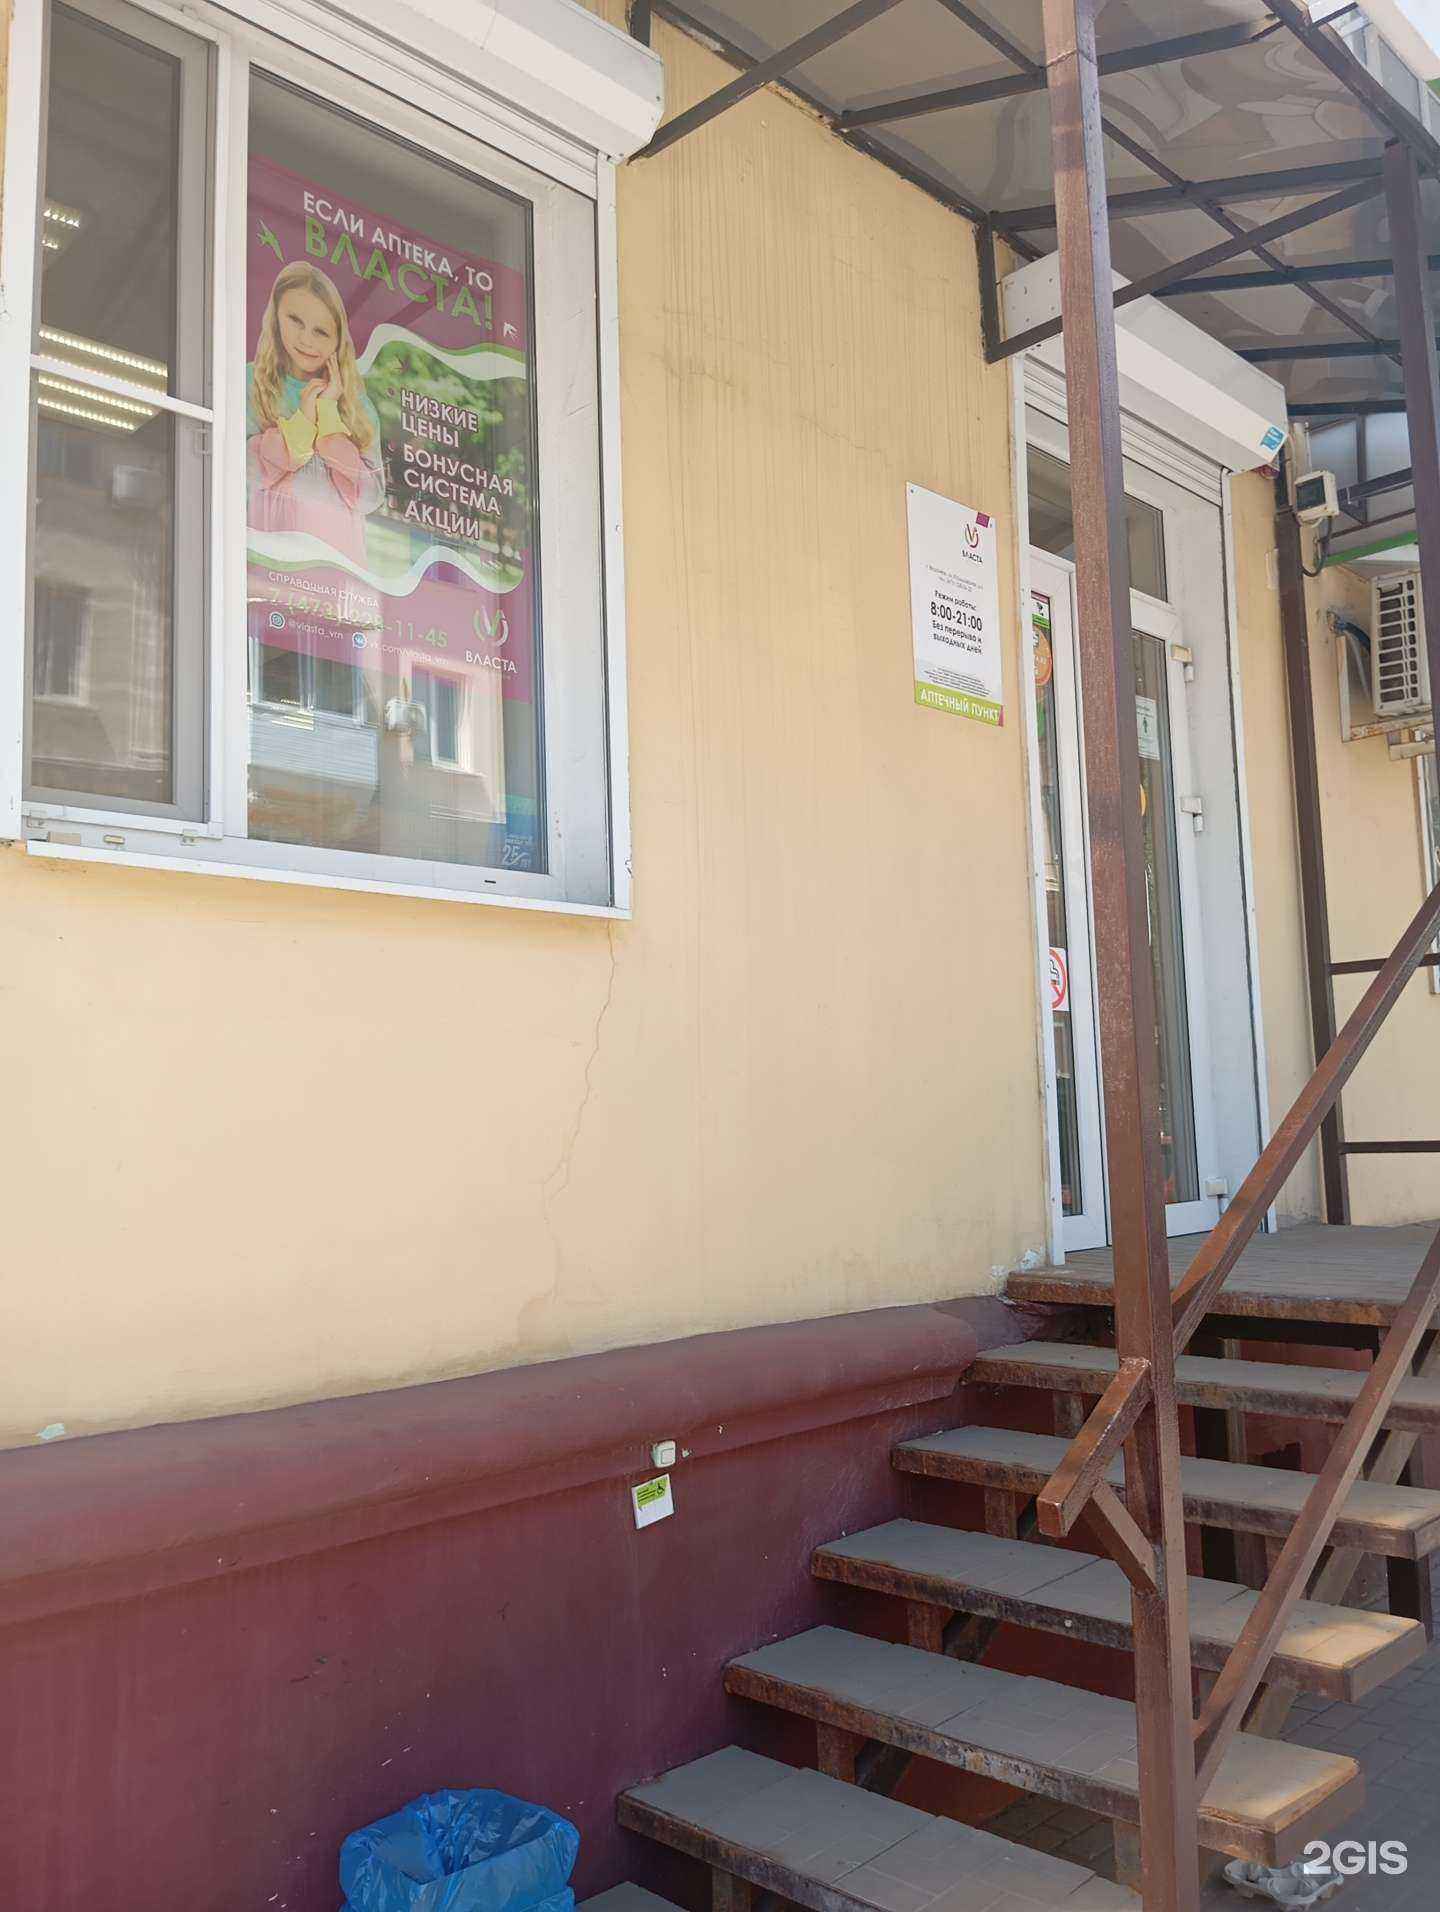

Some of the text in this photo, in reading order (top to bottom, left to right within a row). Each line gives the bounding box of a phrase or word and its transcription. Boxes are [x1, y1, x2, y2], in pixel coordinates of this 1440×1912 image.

[303, 190, 494, 292] ЕСЛИ АПТЕКА, ТО
[305, 216, 494, 331] ВЛАСТА!
[401, 390, 479, 433] НИЗКИЕ
[401, 412, 460, 448] ЦЕНЫ
[403, 443, 514, 497] БОНУСНАЯ
[403, 468, 502, 516] СИСТЕМА
[404, 499, 480, 540] АКЦИИ
[268, 571, 337, 597] СПРАВОЧНАЯ
[930, 601, 983, 632] 8:00-21:00
[465, 649, 518, 674] ВЛАСТА
[920, 687, 998, 721] АПТЕЧНЫЙ ПУНКТ
